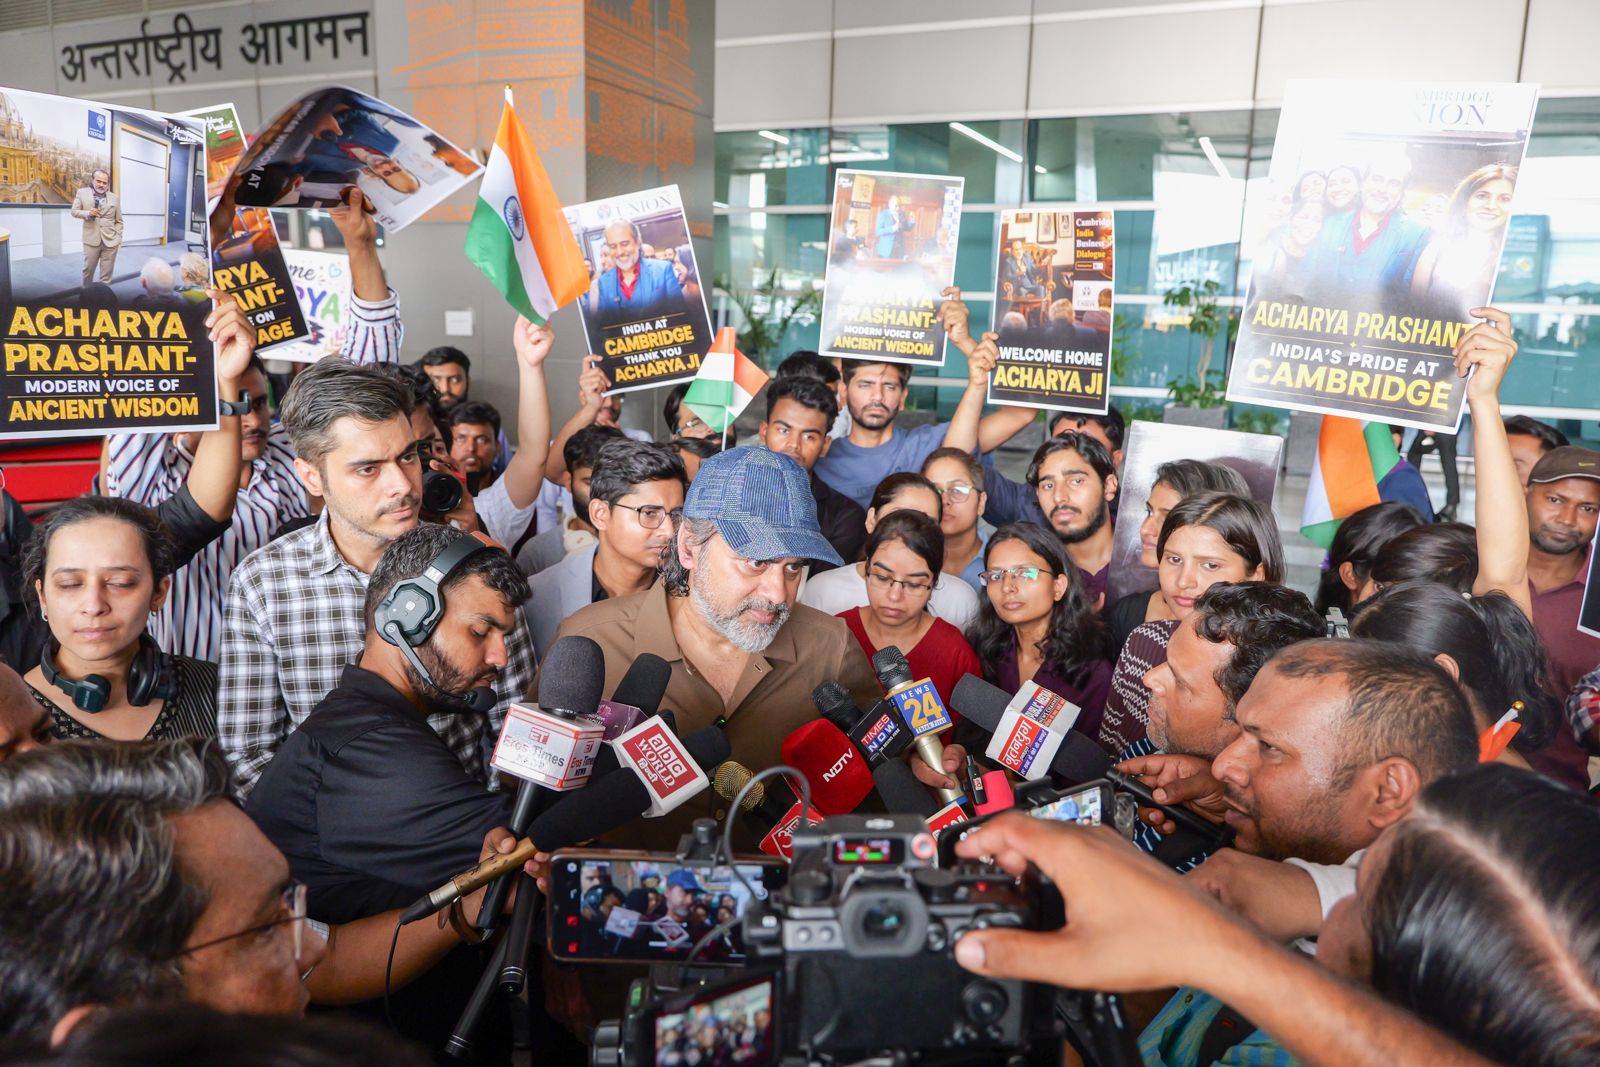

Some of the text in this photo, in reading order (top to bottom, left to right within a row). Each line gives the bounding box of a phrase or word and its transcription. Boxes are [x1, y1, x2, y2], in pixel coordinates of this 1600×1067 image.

[60, 12, 370, 83] अन्तर्राष्ट्रीय आगमन
[247, 173, 262, 189] AT
[1076, 228, 1095, 237] India
[1076, 239, 1105, 248] Business
[1076, 249, 1107, 259] Dialogue
[213, 260, 269, 291] RYA
[8, 306, 187, 338] ACHARYA
[255, 310, 275, 324] ON
[622, 319, 667, 335] INDIA AT
[837, 304, 937, 328] PRASHANT-
[1252, 301, 1348, 336] ACHARYA
[258, 320, 295, 345] AGE
[604, 325, 695, 356] CAMBRIDGE
[844, 325, 925, 340] MODERN VOICE OF
[3, 343, 197, 371] PRASHANT-
[624, 347, 682, 365] THANK YOU
[833, 336, 934, 356] ANCIENT WISDOM
[999, 346, 1104, 366] WELCOME HOME
[615, 353, 700, 382] ACHARYA JI
[1348, 351, 1408, 374] PRIDE
[1413, 360, 1440, 377] AT
[25, 379, 180, 393] MODERN VOICE OF
[993, 365, 1104, 395] ACHARYA JI
[1247, 358, 1453, 411] CAMBRIDGE
[8, 397, 199, 422] ANCIENT WISDOM
[900, 685, 930, 701] NEWS
[903, 691, 943, 729] 24
[861, 713, 891, 746] TIMES
[866, 720, 896, 753] NOW
[1002, 719, 1033, 766] नूतनयुग
[530, 744, 566, 767] Times
[570, 756, 582, 769] Eros
[638, 739, 675, 786] WORLD
[649, 734, 687, 777] abc
[822, 747, 854, 782] NDTV
